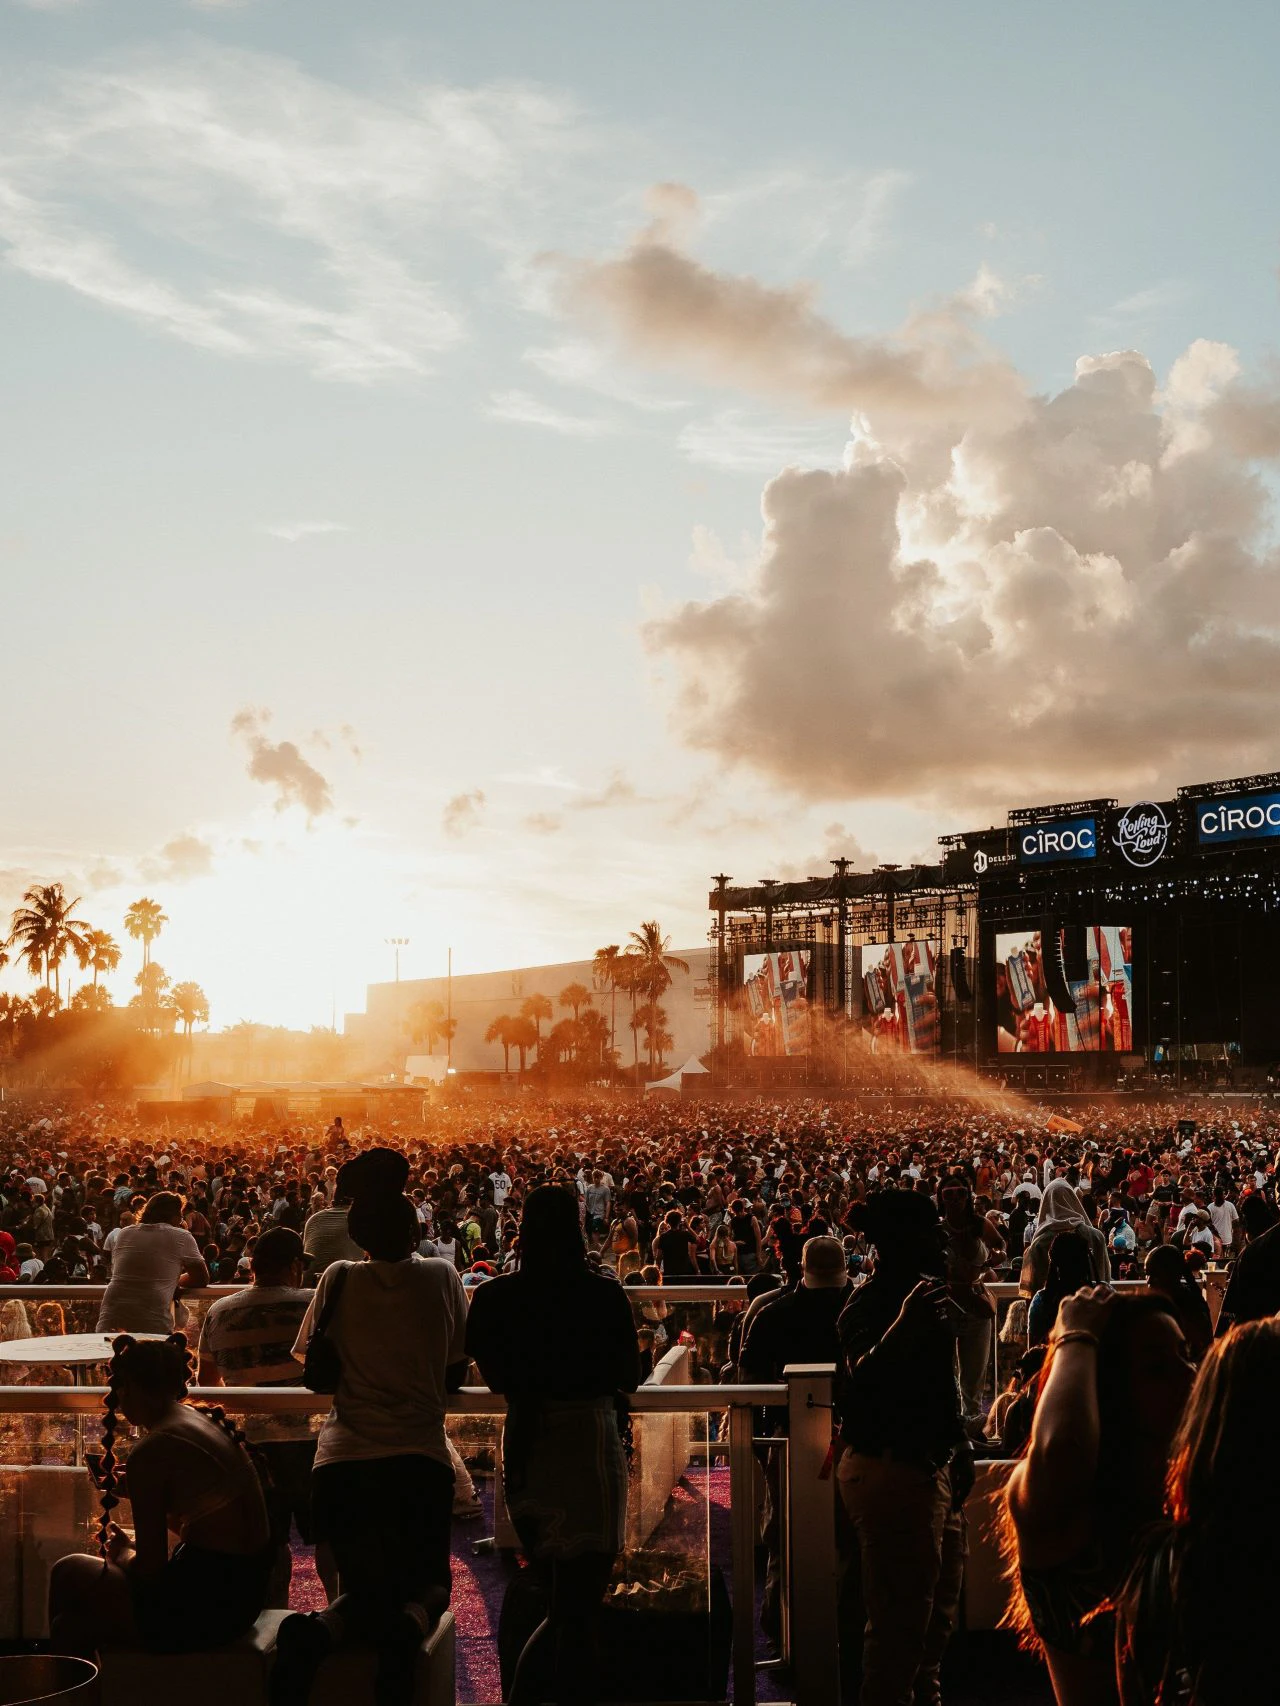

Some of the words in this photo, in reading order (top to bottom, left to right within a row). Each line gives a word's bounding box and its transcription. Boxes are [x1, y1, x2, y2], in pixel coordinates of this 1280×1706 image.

[1117, 813, 1171, 839] Rolling
[1022, 828, 1093, 855] CÎROC
[1121, 830, 1162, 853] Loud
[495, 1180, 505, 1190] 50
